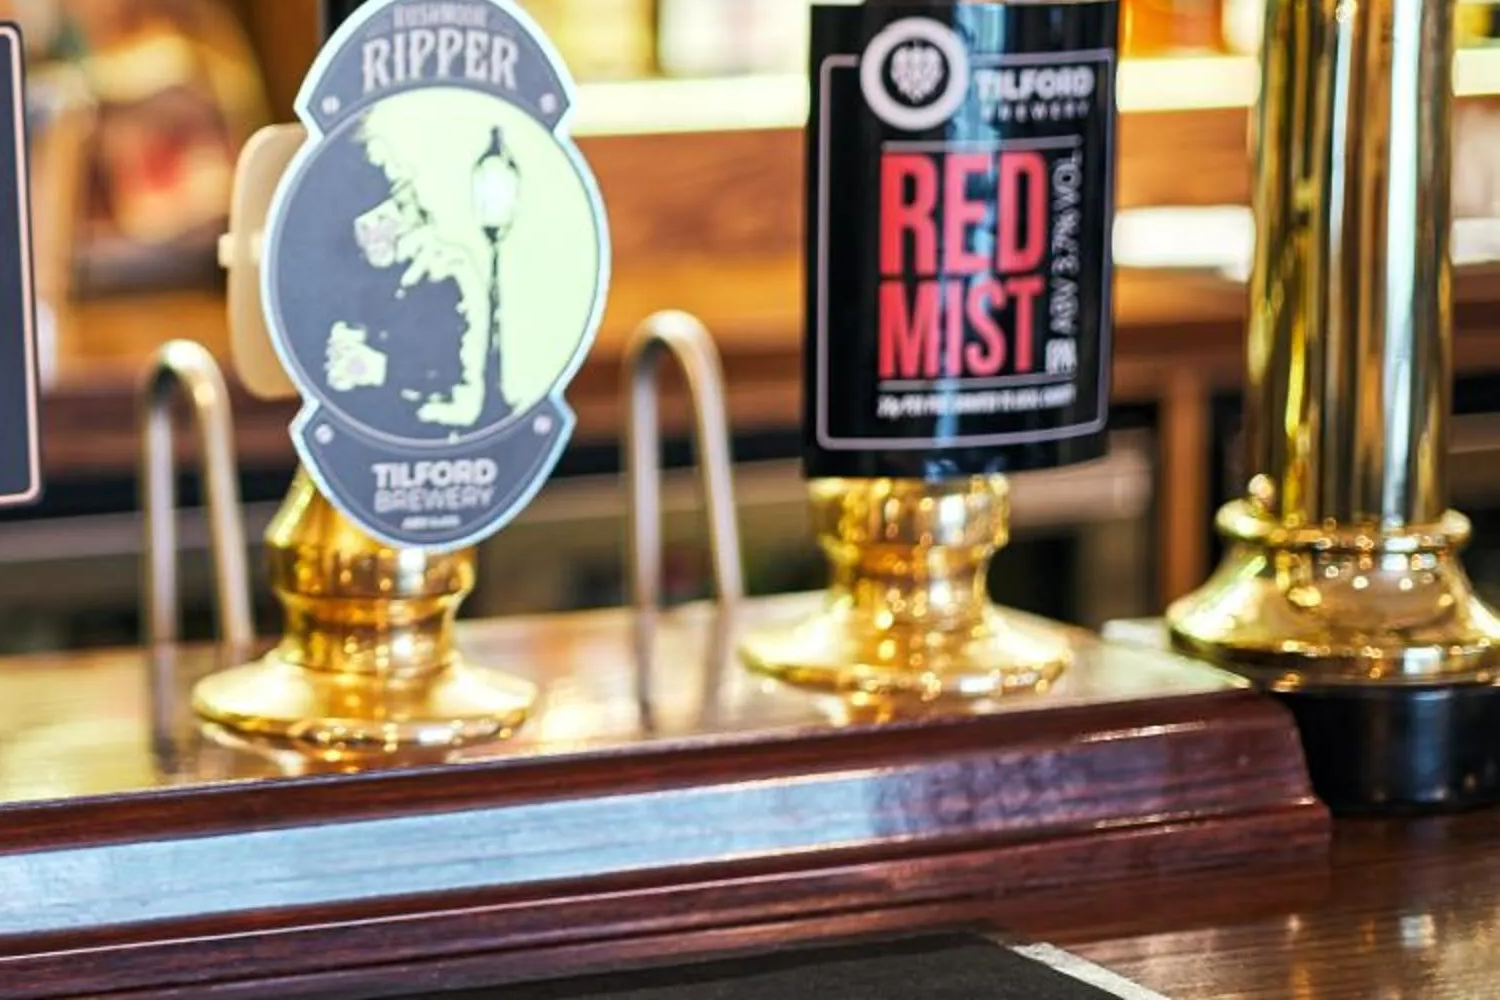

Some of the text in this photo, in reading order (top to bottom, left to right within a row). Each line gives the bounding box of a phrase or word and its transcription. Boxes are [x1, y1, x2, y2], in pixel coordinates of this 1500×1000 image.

[361, 27, 520, 93] RIPPER
[972, 65, 1096, 101] TILFORD
[879, 150, 1050, 277] RED
[876, 274, 1045, 381] MIST
[371, 458, 498, 489] TILFORD
[374, 486, 496, 513] BREWERY
